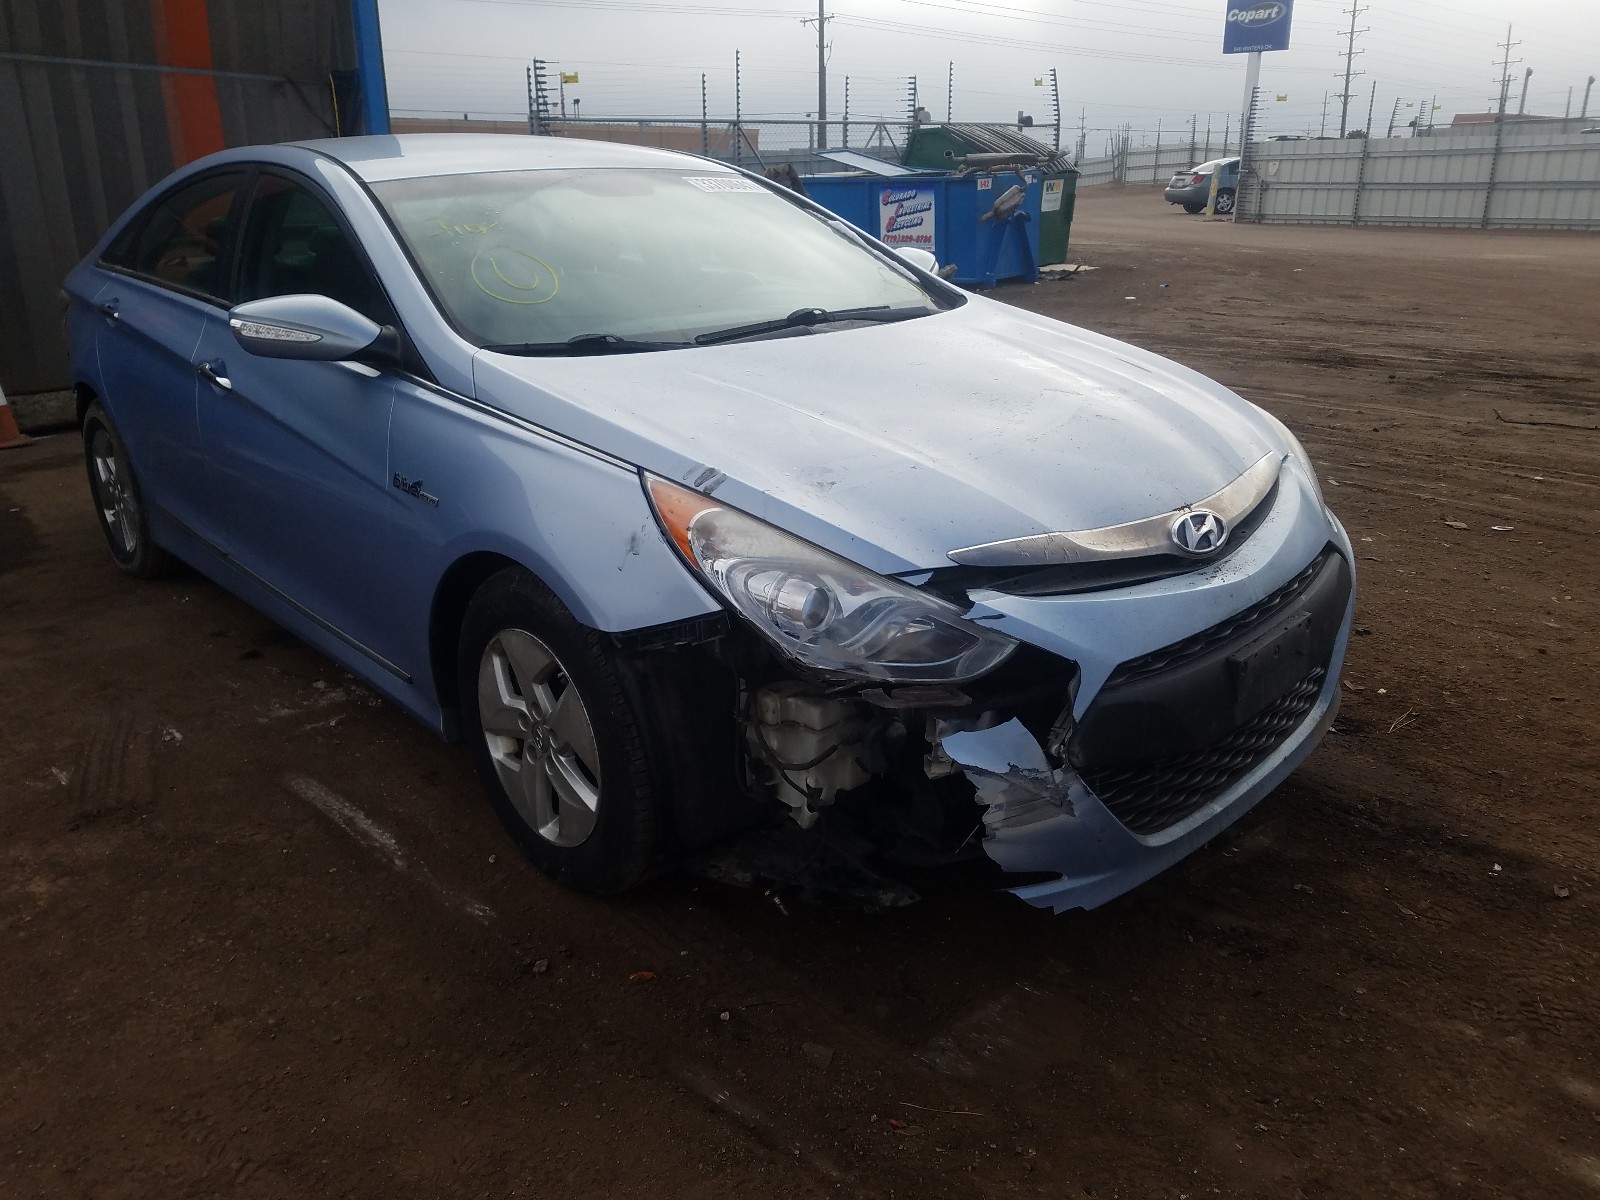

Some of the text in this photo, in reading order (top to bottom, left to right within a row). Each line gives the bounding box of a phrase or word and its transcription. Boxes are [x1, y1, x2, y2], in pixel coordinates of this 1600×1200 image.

[1227, 6, 1279, 23] Copart
[881, 189, 918, 206] COLORADO
[885, 215, 924, 233] RECYCLING
